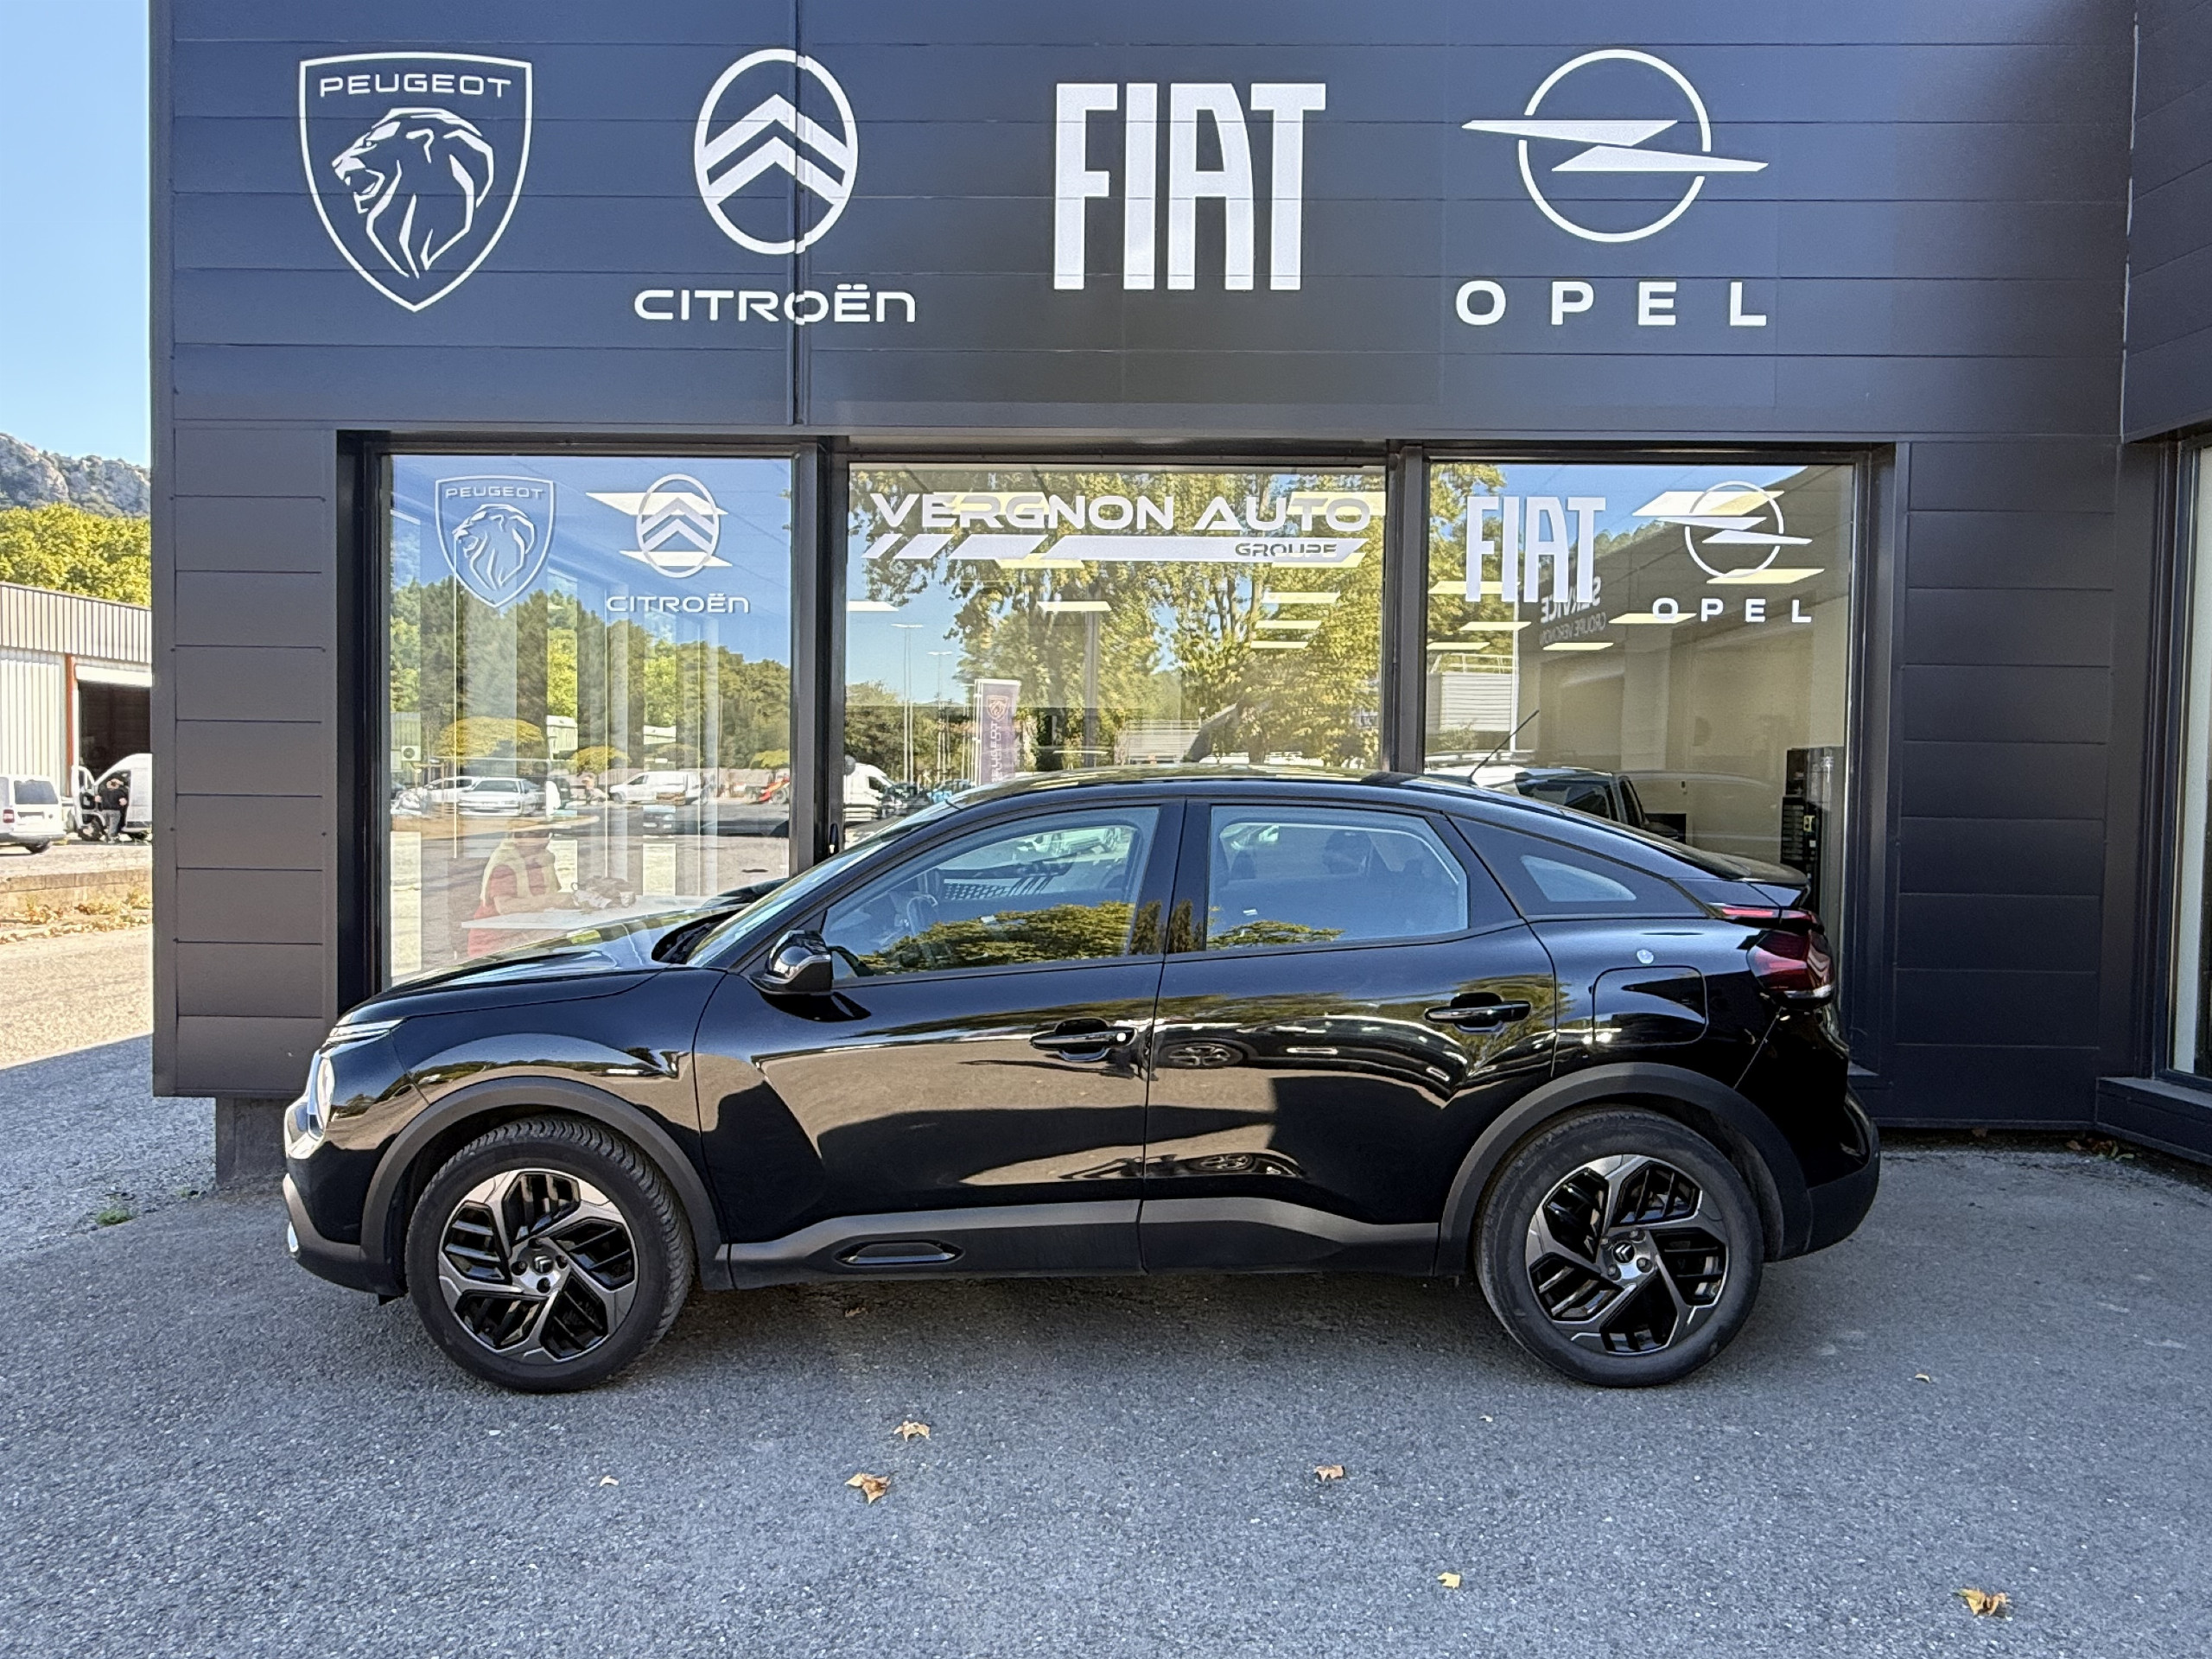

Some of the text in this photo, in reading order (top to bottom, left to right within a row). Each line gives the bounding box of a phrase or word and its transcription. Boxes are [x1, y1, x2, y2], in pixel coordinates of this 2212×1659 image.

[320, 74, 511, 98] PEUGEOT
[1053, 83, 1326, 290] FIAT
[1454, 280, 1767, 327] OPEL
[445, 486, 545, 499] PEUGEOT
[870, 493, 1371, 532] VERGNON AUTO
[1235, 543, 1338, 557] GROUPE
[1465, 496, 1606, 602] FIAT
[1652, 597, 1812, 623] OPEL
